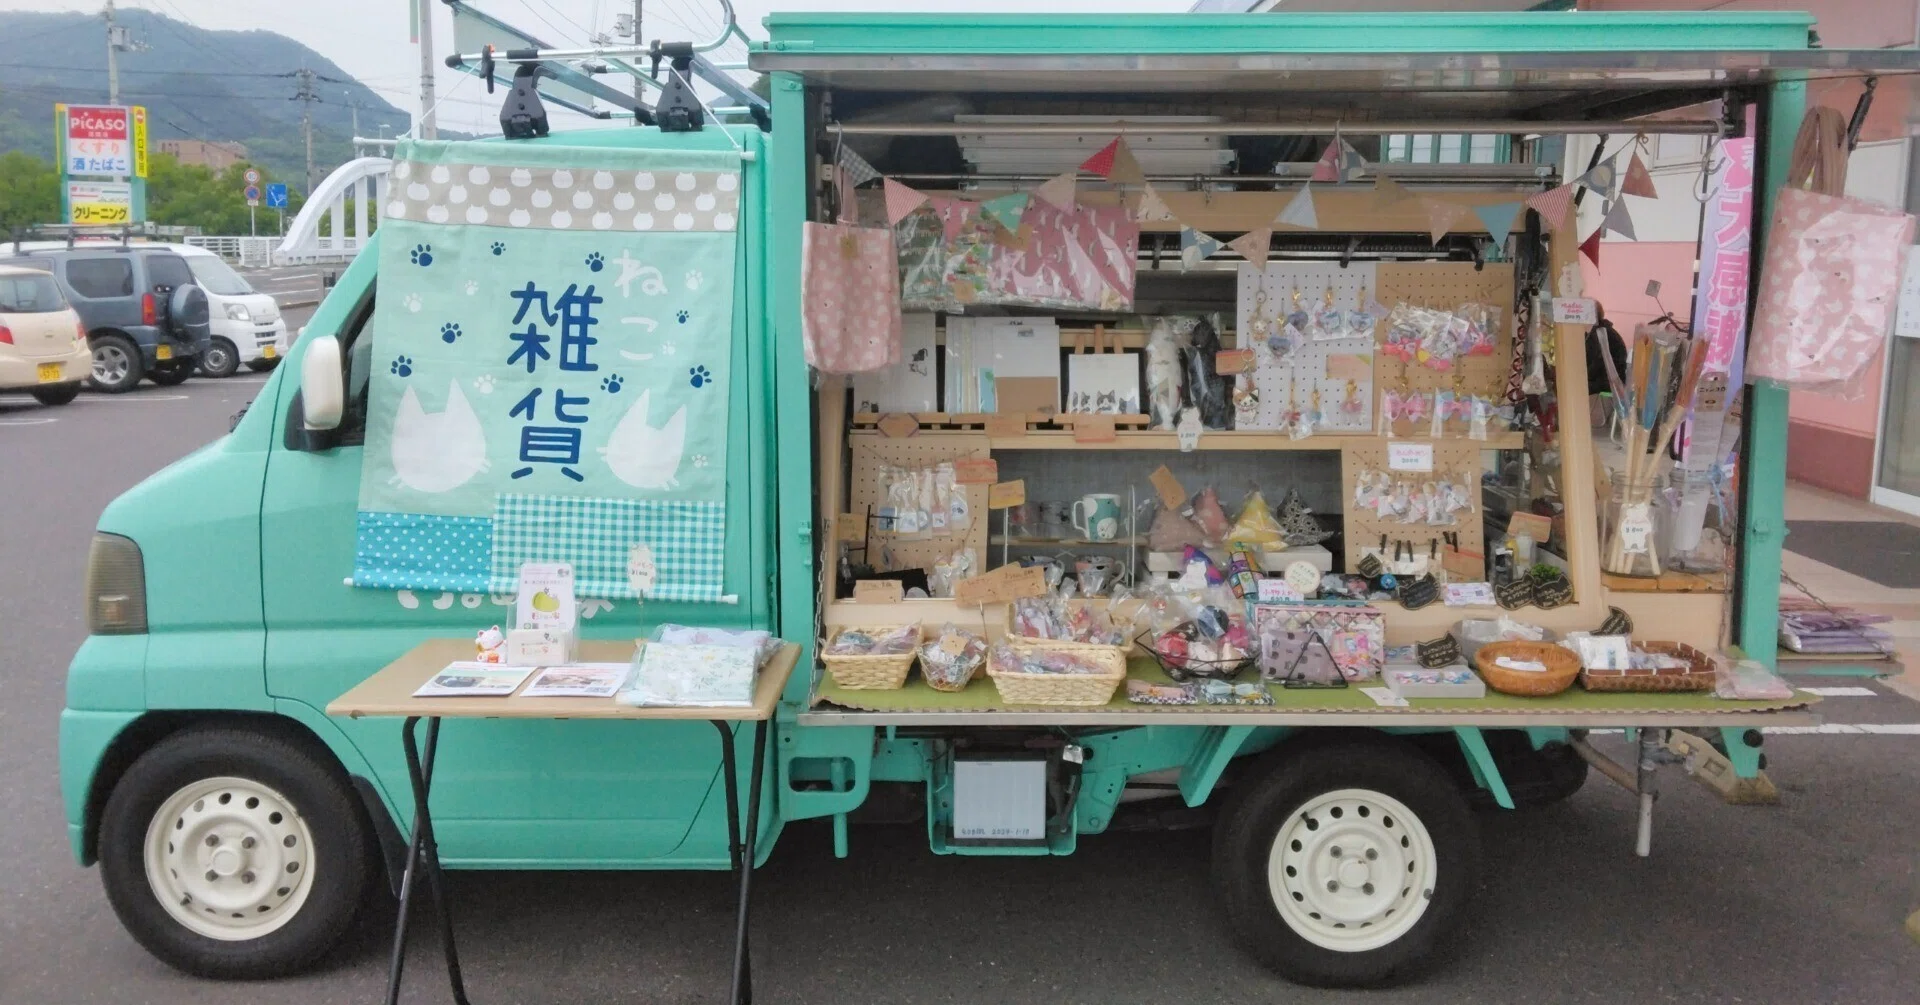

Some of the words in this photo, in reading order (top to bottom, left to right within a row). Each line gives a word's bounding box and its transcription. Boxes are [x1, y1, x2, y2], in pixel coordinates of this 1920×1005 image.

[70, 111, 126, 131] PiCASO
[78, 142, 120, 155] くすり
[72, 157, 86, 171] 酒
[89, 157, 126, 171] たばこ
[73, 206, 128, 220] クリーニング
[611, 248, 669, 361] ねこ
[507, 281, 604, 482] 雑貨
